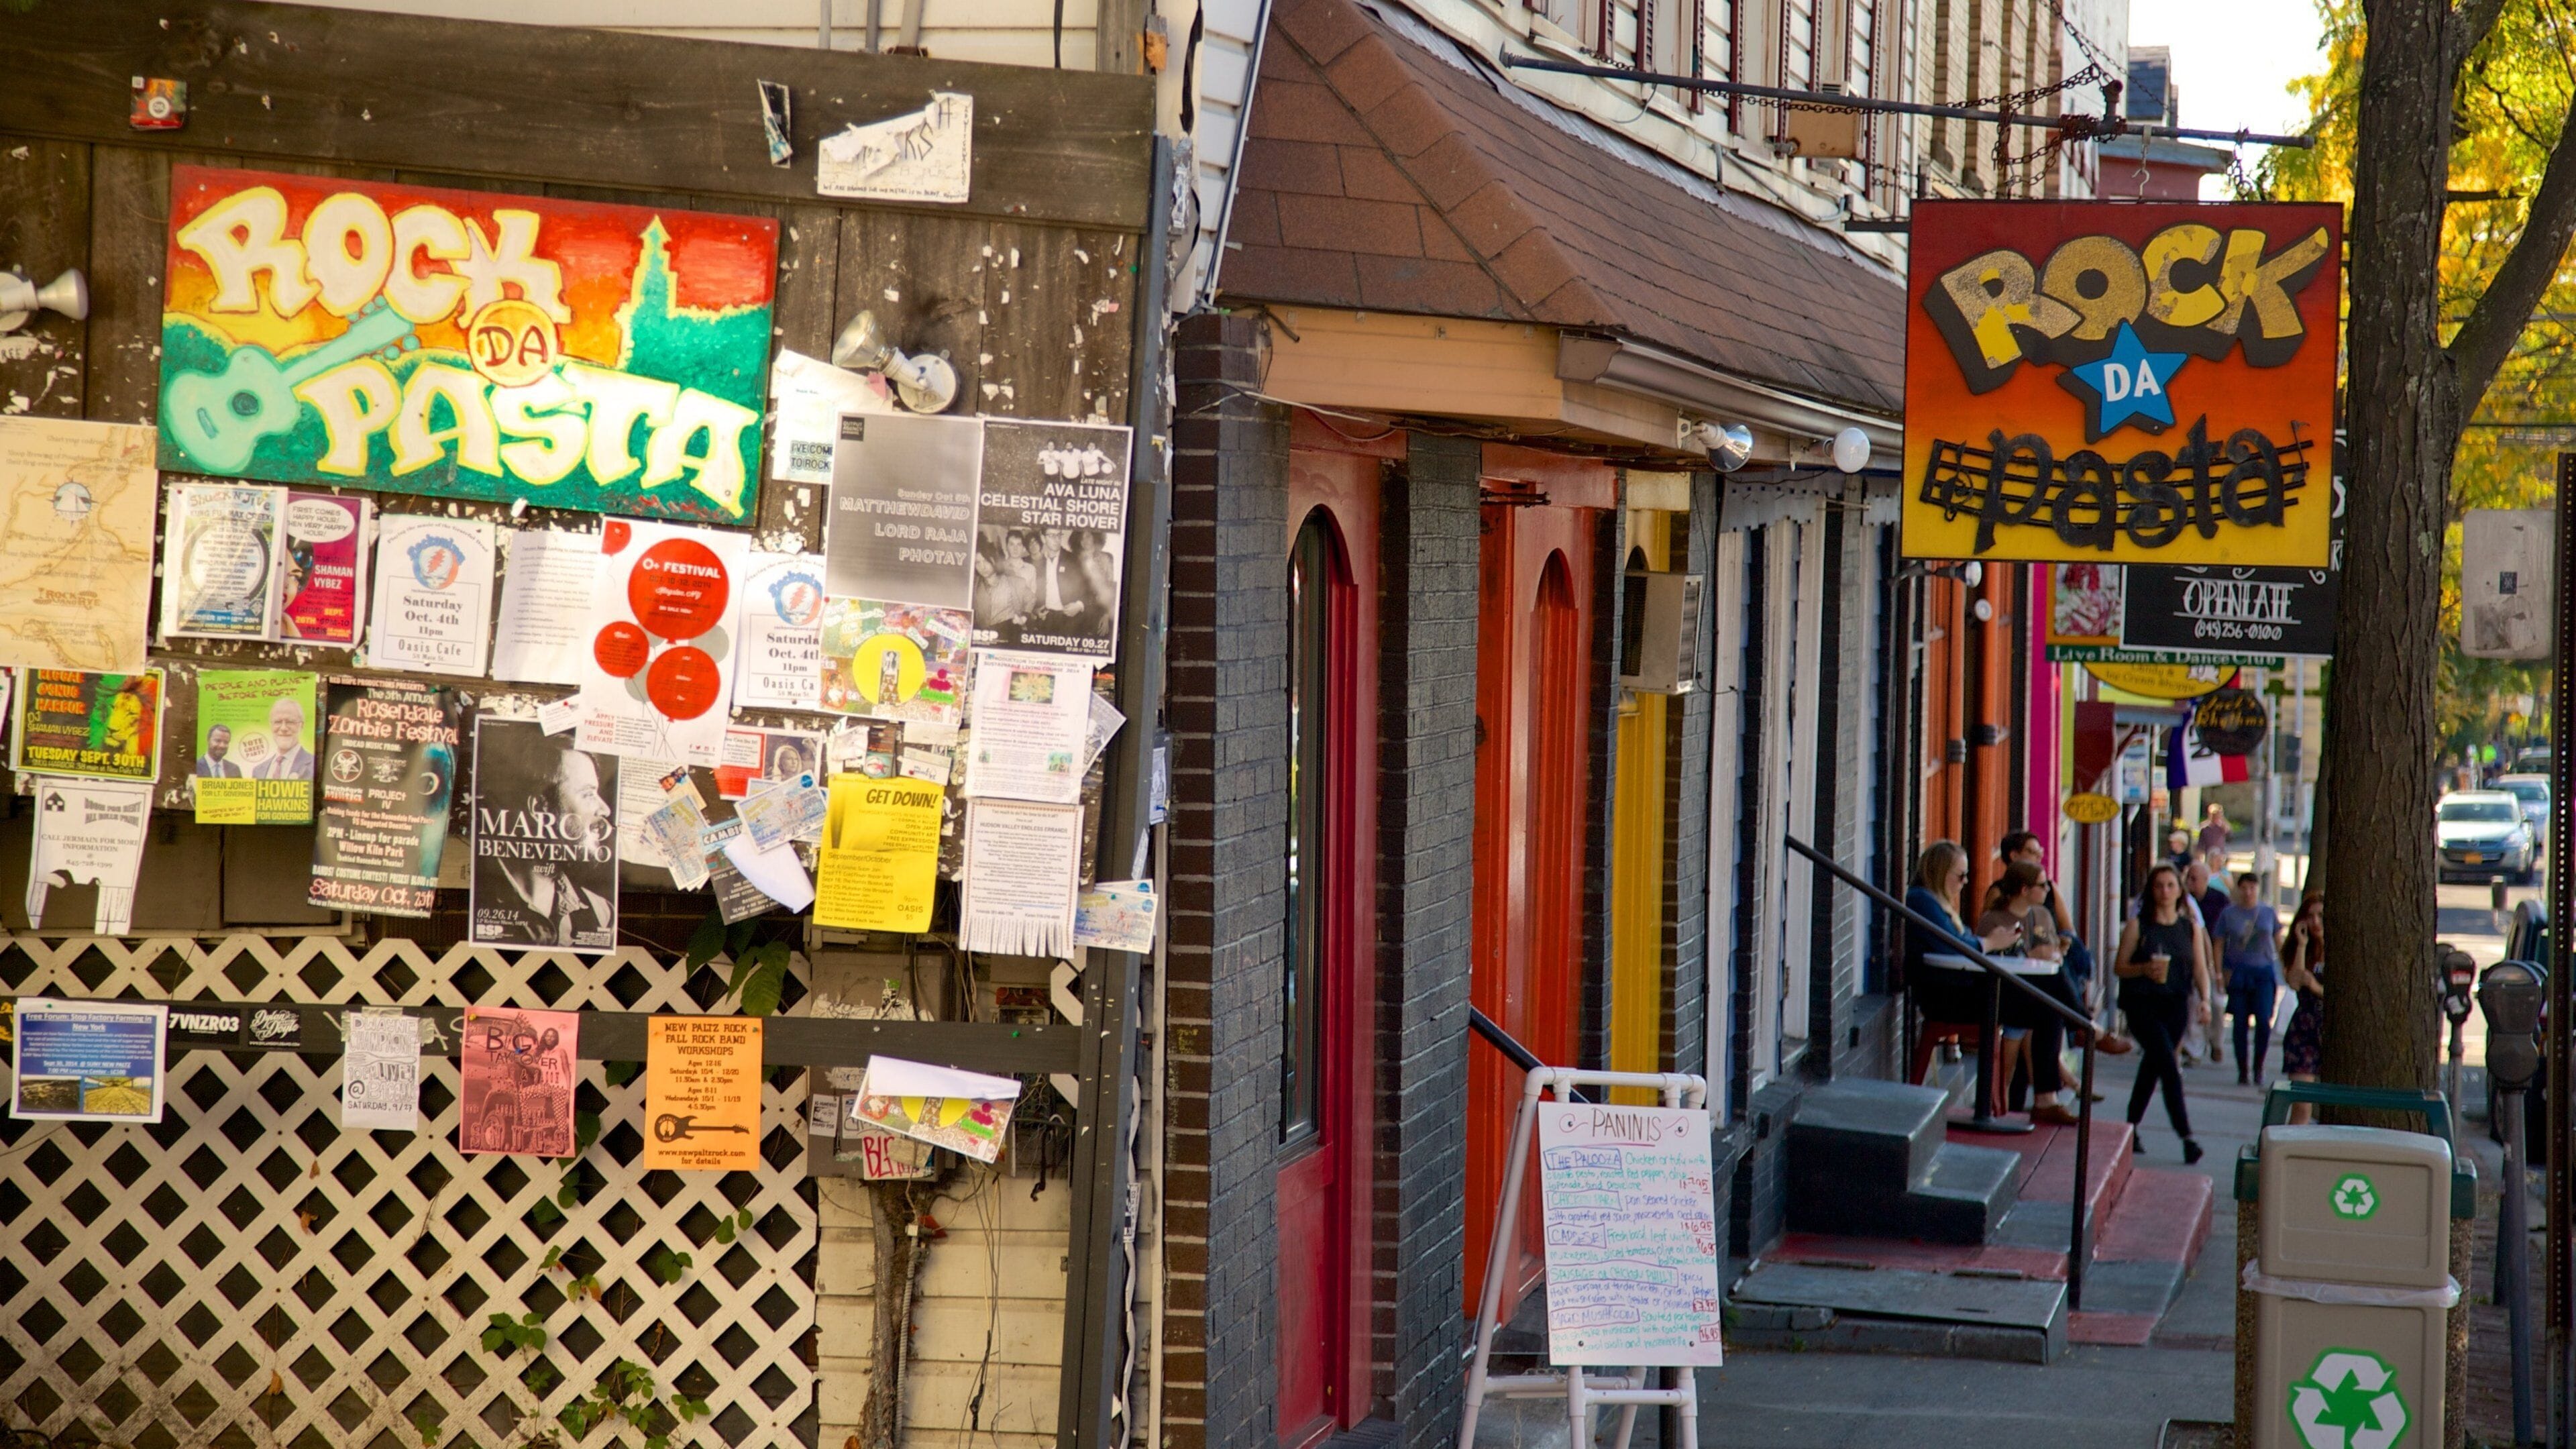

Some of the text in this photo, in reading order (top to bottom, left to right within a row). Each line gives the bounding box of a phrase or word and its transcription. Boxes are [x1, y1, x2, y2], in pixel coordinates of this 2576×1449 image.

[177, 186, 572, 328] ROCK
[1940, 223, 2328, 370] ROCK
[477, 325, 549, 367] DA
[2103, 359, 2161, 402] DA
[294, 362, 758, 518] PASTA
[791, 441, 807, 454] I'VE
[791, 457, 830, 470] TO ROCK
[1095, 479, 1113, 487] NIGHT
[1974, 413, 2285, 554] pasta
[898, 488, 953, 502] Sunday Oct
[1044, 483, 1121, 500] AVA LUNA
[839, 496, 970, 521] MATTHEWDAVID
[981, 493, 1120, 515] CELESTIAL SHORE
[292, 506, 341, 517] FIRST COMES
[292, 513, 340, 523] HAPPY HOUR!
[1021, 511, 1118, 530] STAR ROVER
[304, 529, 327, 537] HOUR!
[325, 523, 347, 532] HAPPY
[875, 523, 967, 543] LORD RAJA
[899, 547, 967, 566] PHOTAY
[315, 565, 354, 577] SHAMAN
[663, 561, 720, 578] FESTIVAL
[314, 578, 342, 589] VYBEZ
[403, 595, 463, 612] Saturday
[405, 610, 459, 625] Oct. 4th
[419, 626, 443, 637] 11pm
[973, 629, 1110, 649] BSP SATURDAY 09.27
[398, 639, 462, 655] Oasis Cafe
[769, 647, 796, 659] Oct.
[2054, 647, 2276, 665] Live Room & Dance Club
[783, 663, 807, 674] 11pm
[205, 676, 311, 692] PEOPLE AND PLANET
[763, 677, 794, 689] Oasis
[217, 690, 258, 701] BEFORE
[368, 688, 435, 704] The Annual
[28, 711, 41, 723] DJ
[357, 698, 444, 724] Rosendale
[27, 724, 90, 737] SHAMAN VYBEZ
[328, 714, 459, 745] Zombie Festival
[584, 719, 614, 729] PRESSURE
[242, 738, 264, 747] VOTE
[342, 739, 382, 749] UNDEAD MUSIC
[587, 735, 612, 744] ELEVATE
[244, 745, 265, 753] GREEN
[246, 750, 265, 758] PARTY
[28, 745, 146, 767] TUESDAY SEPT. 30TH
[202, 781, 254, 790] BRIAN JONES
[258, 781, 309, 798] HOWIE
[257, 798, 309, 812] HAWKINS
[866, 789, 938, 809] GET DOWN!
[257, 812, 309, 820] FOR GOVERNOR
[479, 807, 612, 841] MARCO
[42, 833, 60, 841] CALL
[62, 835, 98, 843] JERMAIN
[327, 826, 419, 847] 2PM Lineup for parade
[62, 843, 118, 852] INFORMATION
[339, 841, 404, 857] Willow Kiln Park
[478, 839, 612, 863] BENEVENTO
[828, 852, 892, 864] September/October
[532, 863, 555, 875] swift
[309, 877, 411, 905] Saturday Oct.
[477, 908, 519, 920] 09.26.14
[898, 904, 924, 913] OASIS
[476, 925, 502, 936] BSP
[70, 1014, 87, 1022] Stop
[89, 1014, 114, 1022] Factory
[115, 1015, 144, 1023] Farming
[252, 1009, 288, 1026] Dylan
[72, 1023, 106, 1031] New York
[260, 1018, 300, 1039] Doyle
[354, 1018, 417, 1034] DWAYNE
[665, 1023, 747, 1032] NEW PALTZ ROCK
[665, 1034, 745, 1044] FALL ROCK BAND
[678, 1046, 734, 1055] WORKSHOPS
[688, 1059, 702, 1068] Ages
[348, 1080, 366, 1099] @
[1592, 1108, 1662, 1142] PANINIS
[696, 1157, 721, 1165] details
[1548, 1152, 1572, 1169] THE
[1625, 1152, 1657, 1165] Chicken
